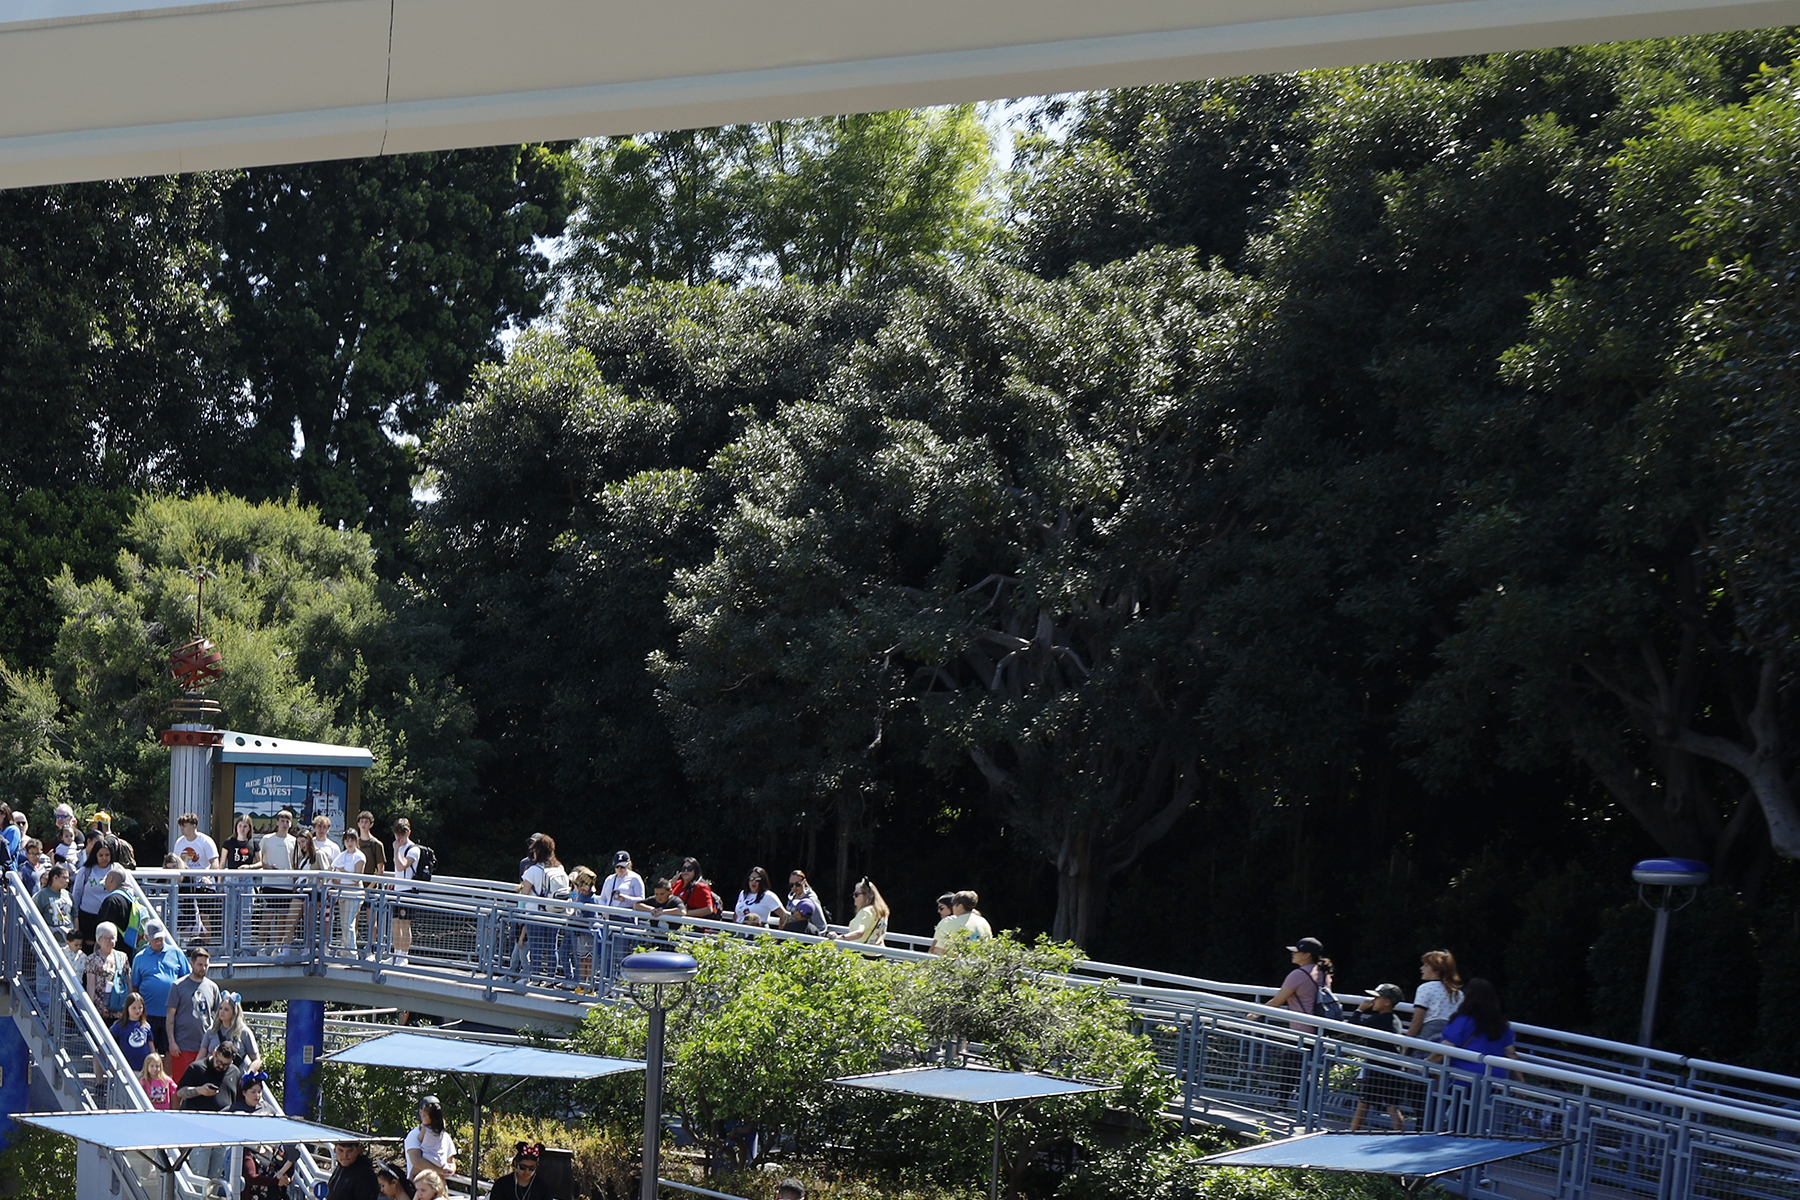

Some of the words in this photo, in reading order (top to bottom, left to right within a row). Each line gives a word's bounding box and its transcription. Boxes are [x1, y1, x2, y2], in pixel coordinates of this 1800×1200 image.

[245, 779, 261, 788] RIDE
[263, 775, 282, 784] INTO
[268, 788, 293, 796] WEST
